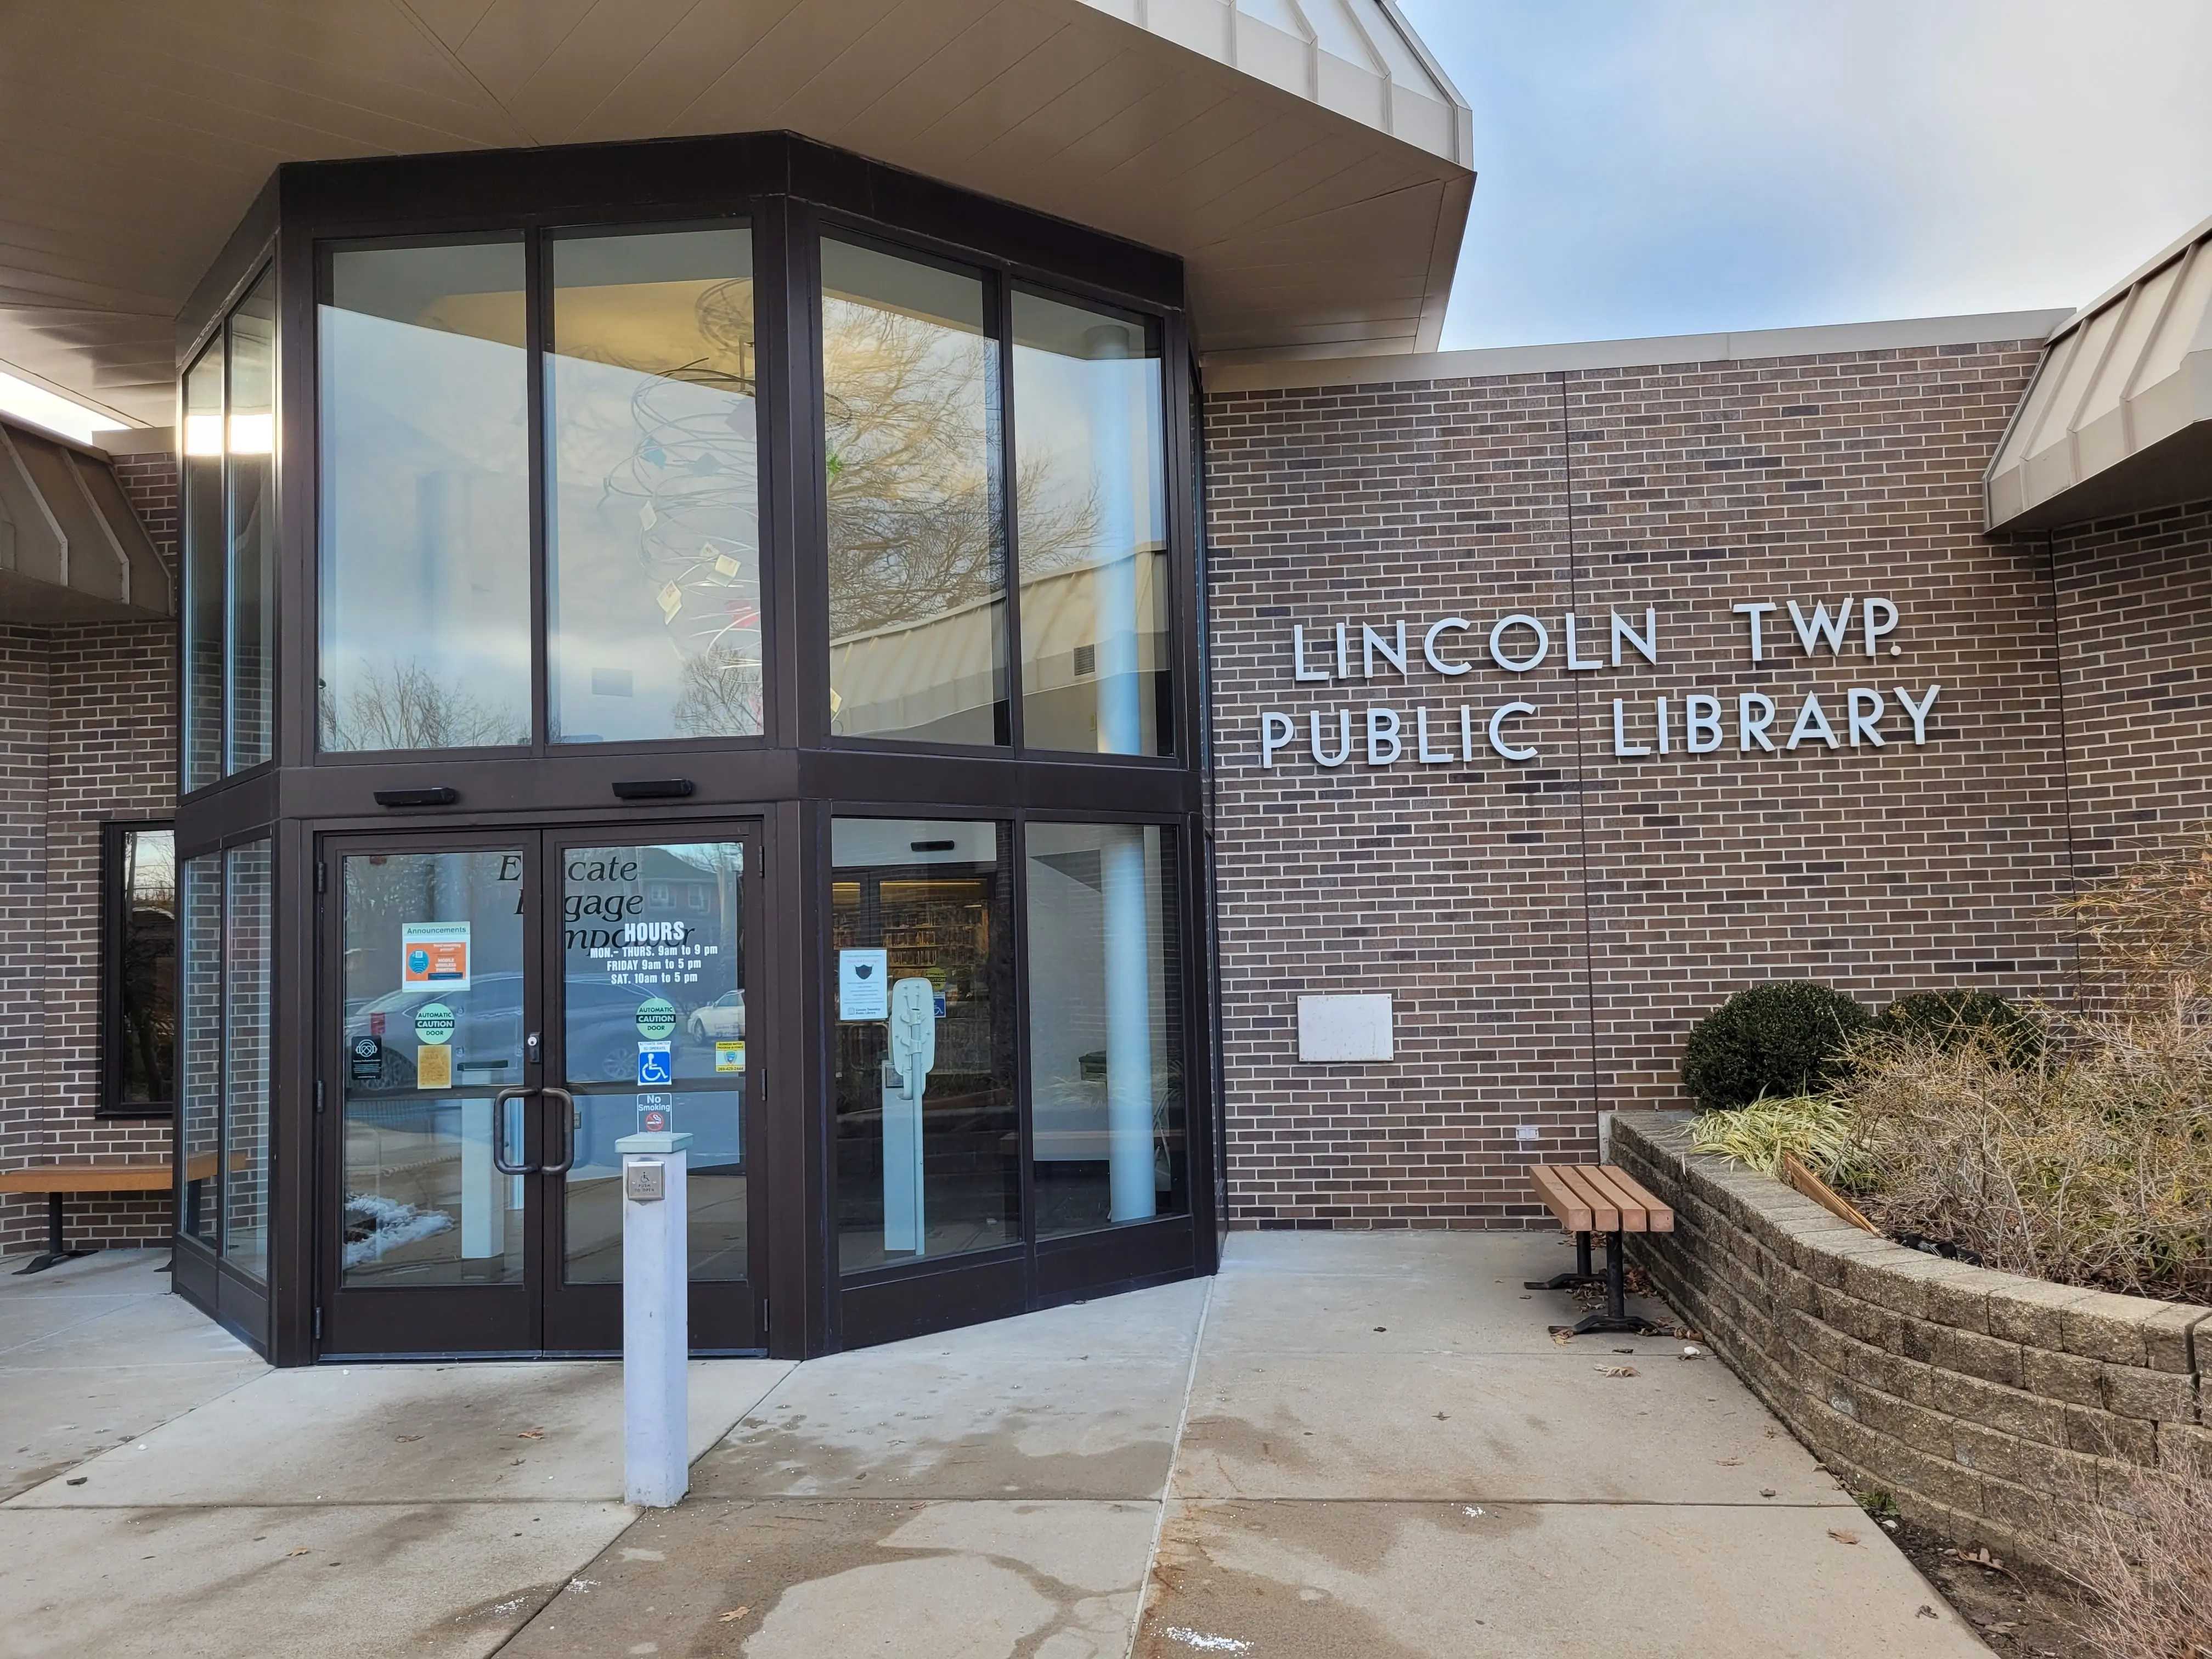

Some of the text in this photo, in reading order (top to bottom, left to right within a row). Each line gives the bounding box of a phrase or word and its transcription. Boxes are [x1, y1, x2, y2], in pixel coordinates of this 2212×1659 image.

[1294, 597, 1902, 681] LINCOLN TWP.
[1262, 684, 1942, 769] PUBLIC LIBRARY
[497, 855, 638, 881] Ecate
[624, 921, 685, 942] HOURS
[622, 946, 655, 957] THURS.
[658, 945, 678, 956] 9am
[681, 945, 691, 955] to
[694, 944, 701, 955] 9
[704, 945, 718, 956] pm
[607, 958, 702, 971] FRIDAY 9am to 5 pm
[611, 972, 698, 984] SAT. 10am to 5 pm
[647, 1094, 662, 1104] No
[638, 1103, 670, 1112] Smoking
